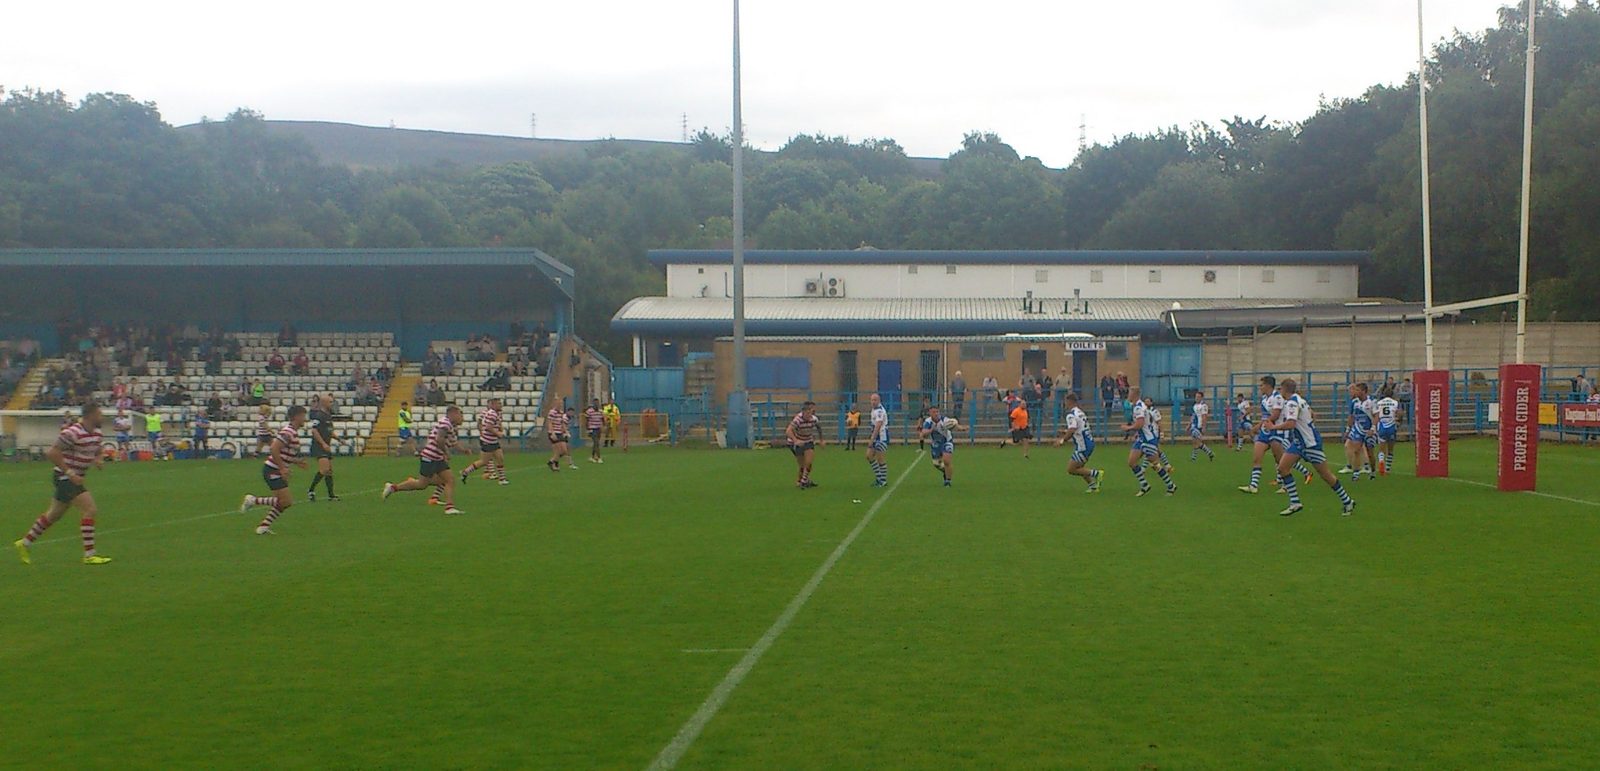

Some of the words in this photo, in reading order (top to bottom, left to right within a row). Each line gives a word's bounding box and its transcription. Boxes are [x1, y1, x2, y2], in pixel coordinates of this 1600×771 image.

[1067, 341, 1105, 350] TOILETS
[1382, 406, 1391, 416] 6
[1429, 388, 1441, 419] CIDER
[1515, 386, 1529, 421] CIDER
[1429, 421, 1441, 461] PROPER
[1513, 424, 1528, 471] PROPER
